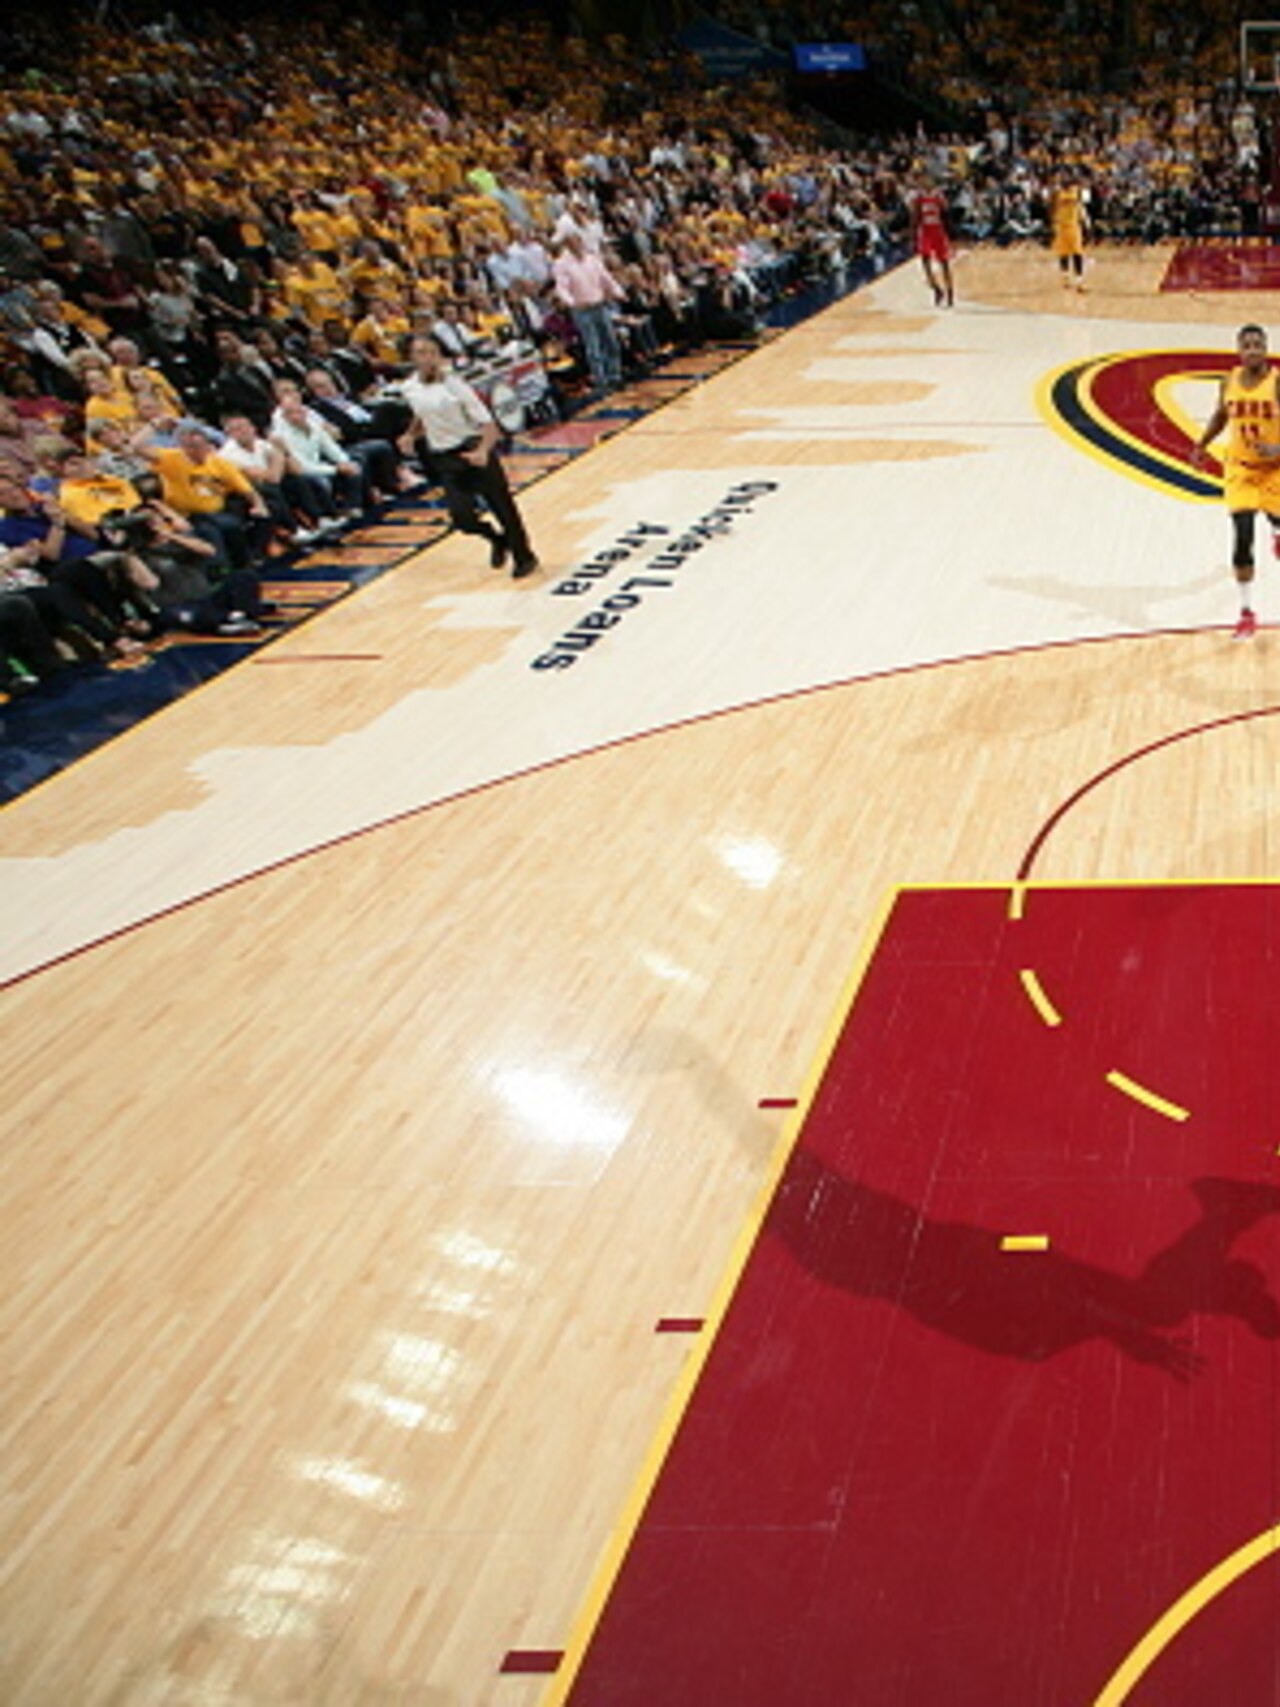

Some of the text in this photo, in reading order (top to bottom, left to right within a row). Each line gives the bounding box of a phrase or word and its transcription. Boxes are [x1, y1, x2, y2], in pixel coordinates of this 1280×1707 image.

[530, 481, 778, 671] Quicken Loans
[550, 521, 670, 596] Arena
